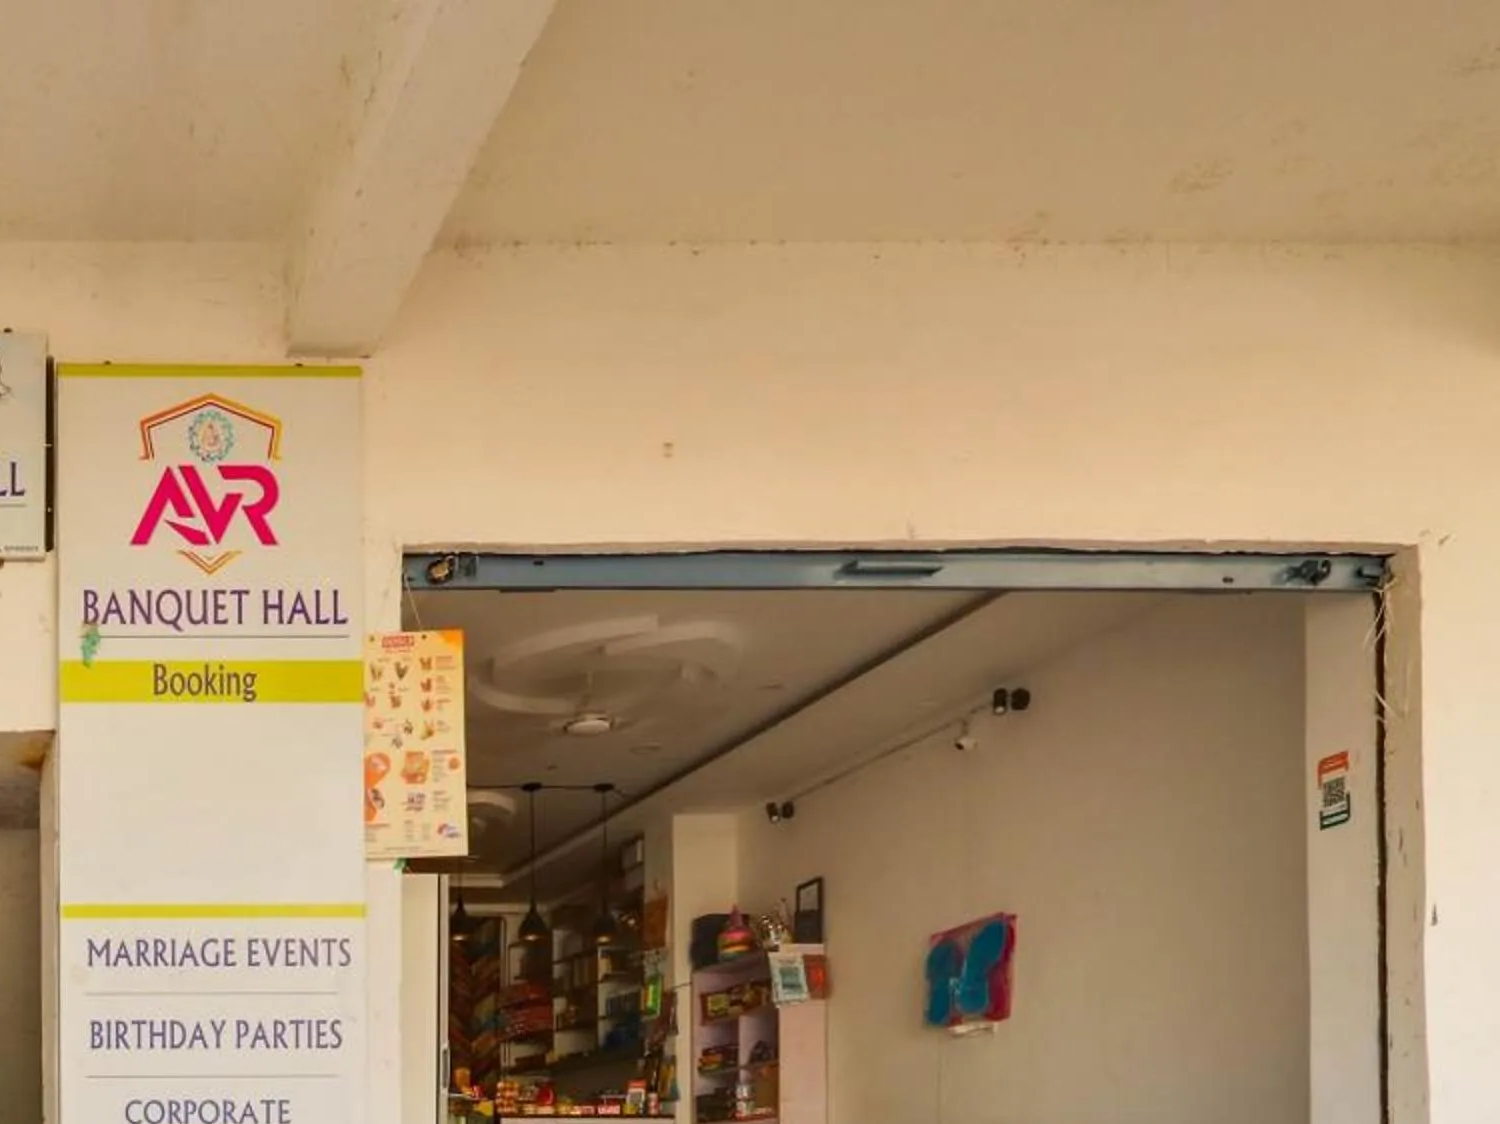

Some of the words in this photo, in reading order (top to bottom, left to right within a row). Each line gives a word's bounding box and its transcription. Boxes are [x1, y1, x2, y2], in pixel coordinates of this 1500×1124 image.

[129, 465, 280, 546] AVR
[82, 589, 251, 633] BANQUET
[262, 589, 350, 625] HALL
[152, 663, 258, 703] Booking
[86, 938, 238, 968] MARRIAGE
[246, 938, 353, 968] EVENTS
[89, 1020, 227, 1050] BIRTHDAY
[234, 1020, 344, 1050] PARTIES
